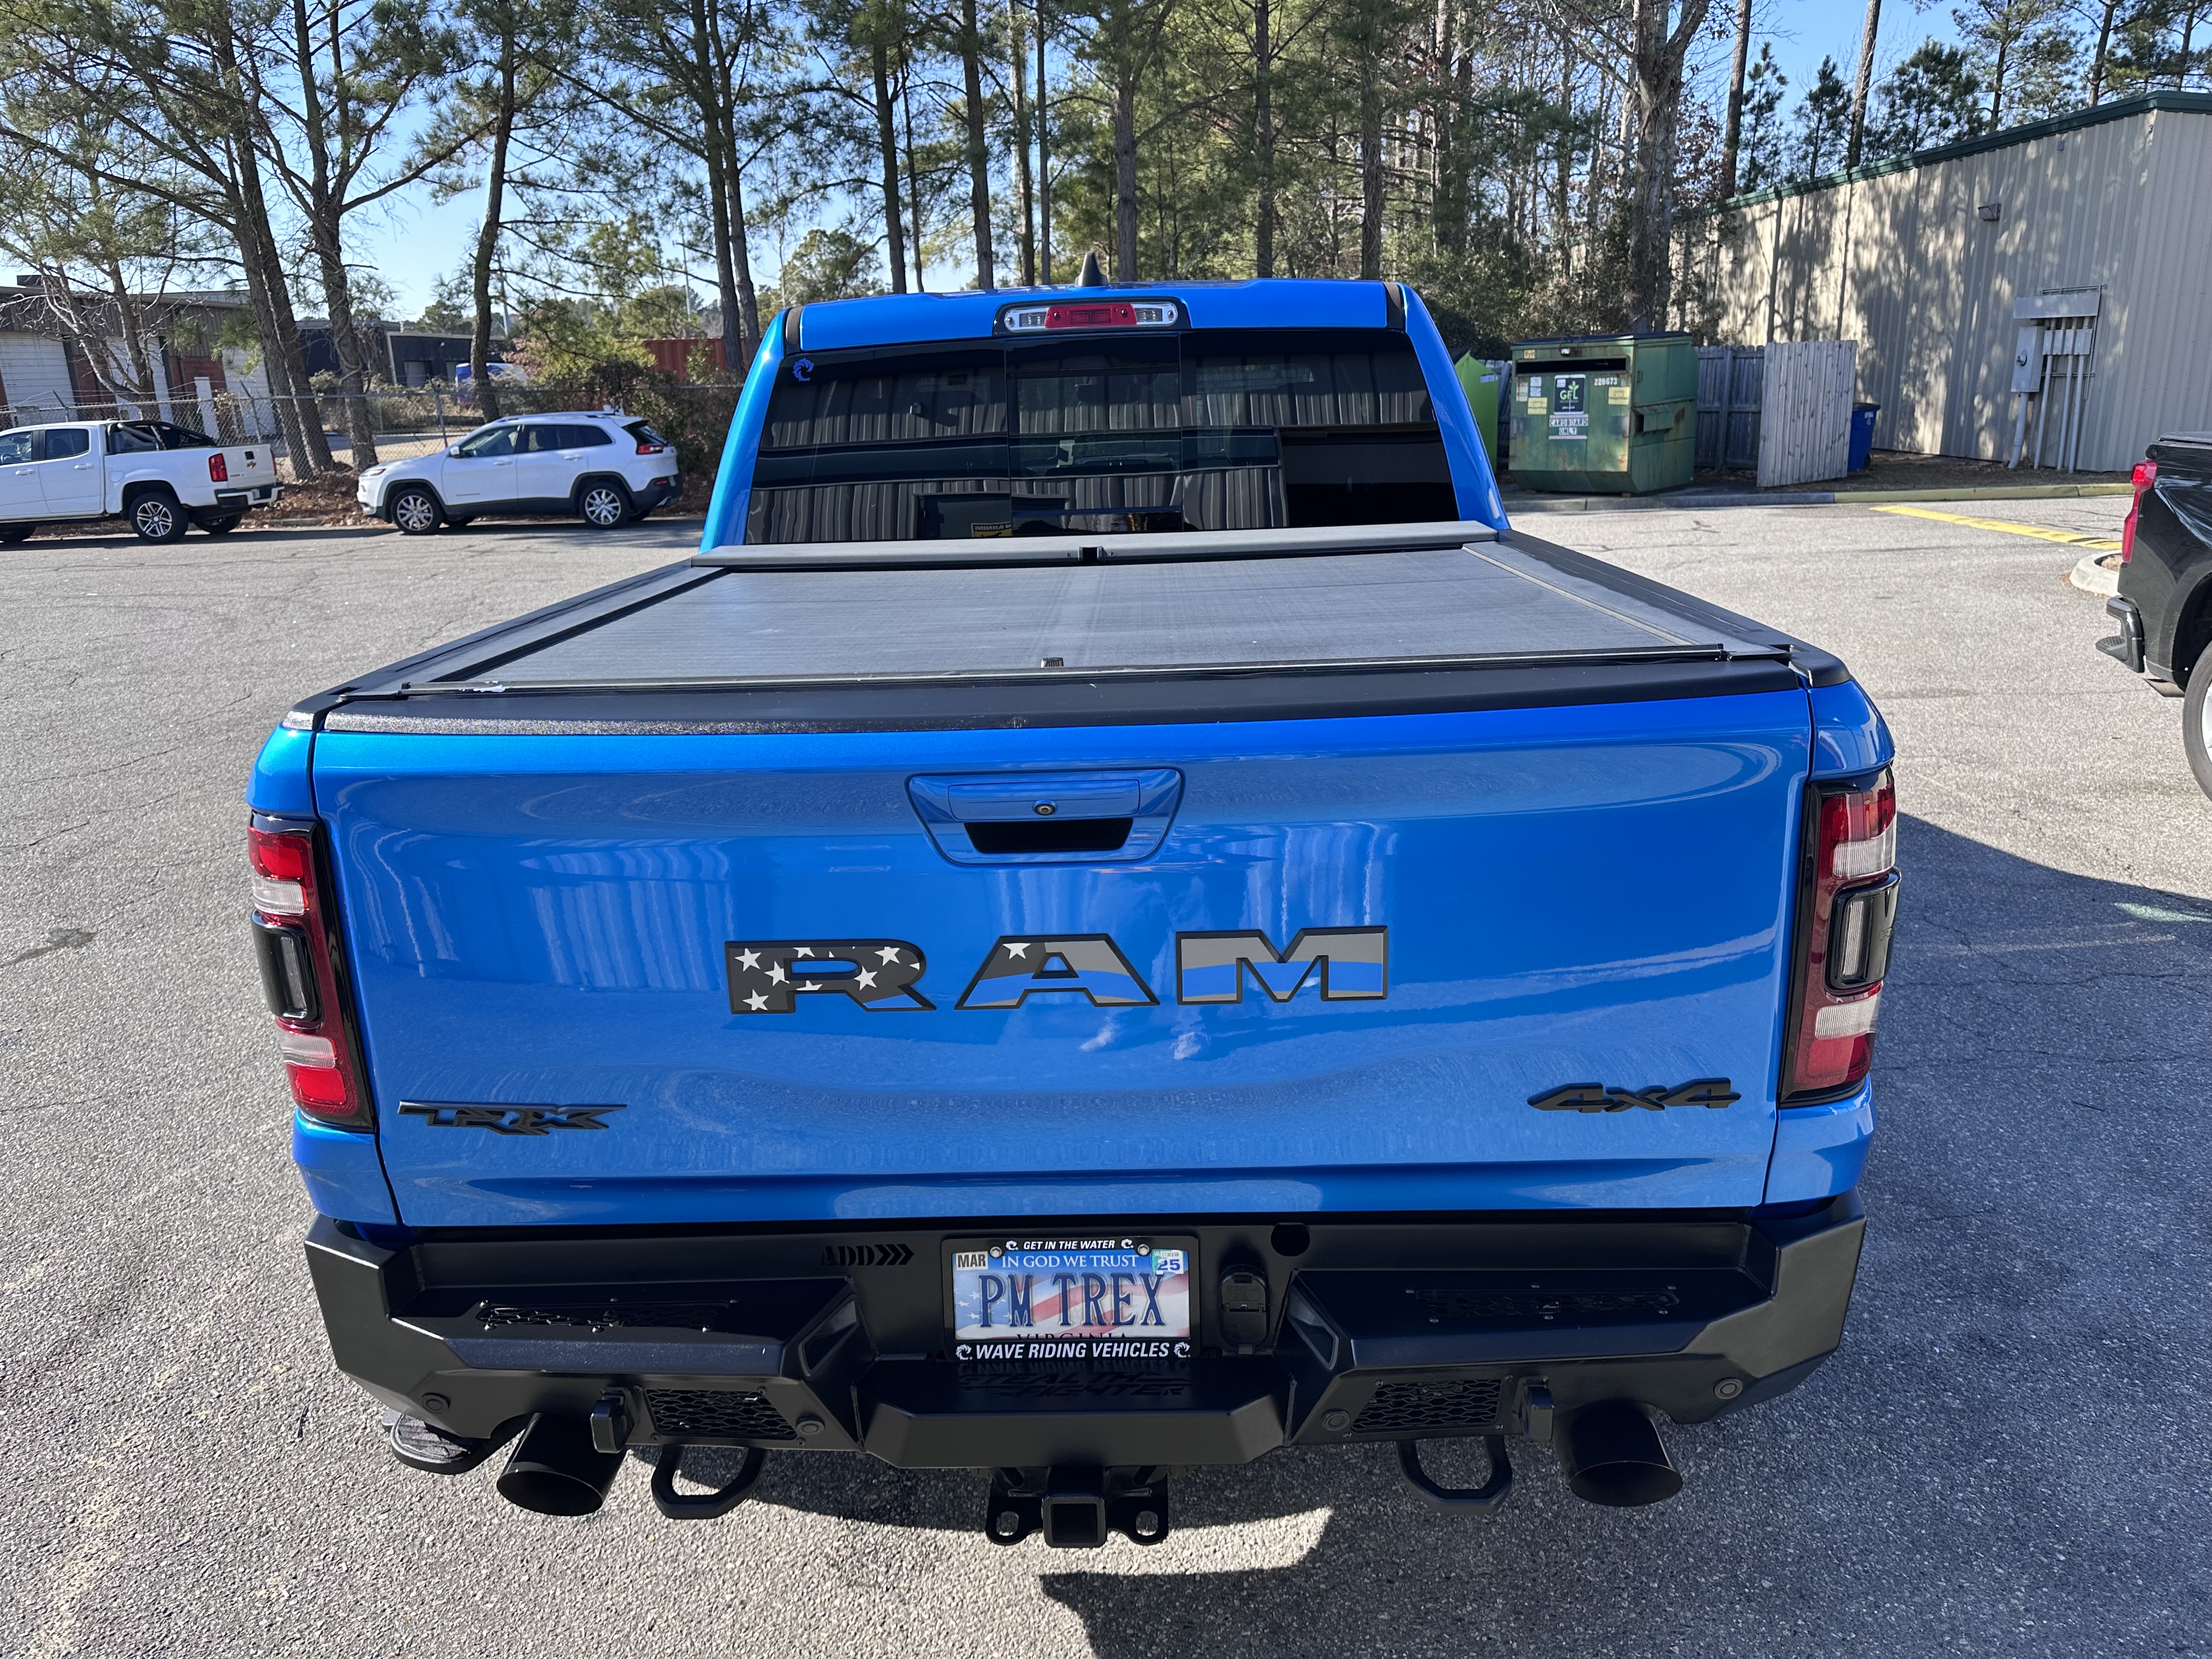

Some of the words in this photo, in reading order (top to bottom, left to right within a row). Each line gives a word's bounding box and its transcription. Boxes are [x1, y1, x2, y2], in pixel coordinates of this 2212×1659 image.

[1559, 386, 1579, 400] GFL
[1549, 418, 1588, 427] CARDBOARD
[724, 925, 1389, 1014] RAM
[397, 1099, 628, 1136] TRX
[1023, 1241, 1043, 1250] GET
[1044, 1240, 1057, 1249] IN
[1059, 1240, 1078, 1249] THE
[1080, 1240, 1115, 1249] WATER
[819, 1245, 875, 1266] ADD
[957, 1254, 986, 1268] MAR
[1002, 1256, 1019, 1268] IN
[1023, 1255, 1060, 1268] GOD
[1063, 1255, 1087, 1267] WE
[1089, 1254, 1139, 1267] TRUST
[1157, 1259, 1181, 1271] 25
[978, 1273, 1035, 1328] PM
[1052, 1272, 1166, 1327] TREX
[976, 1343, 1025, 1359] WAVE
[1028, 1343, 1087, 1359] RIDING
[1092, 1342, 1170, 1358] VEHICLES
